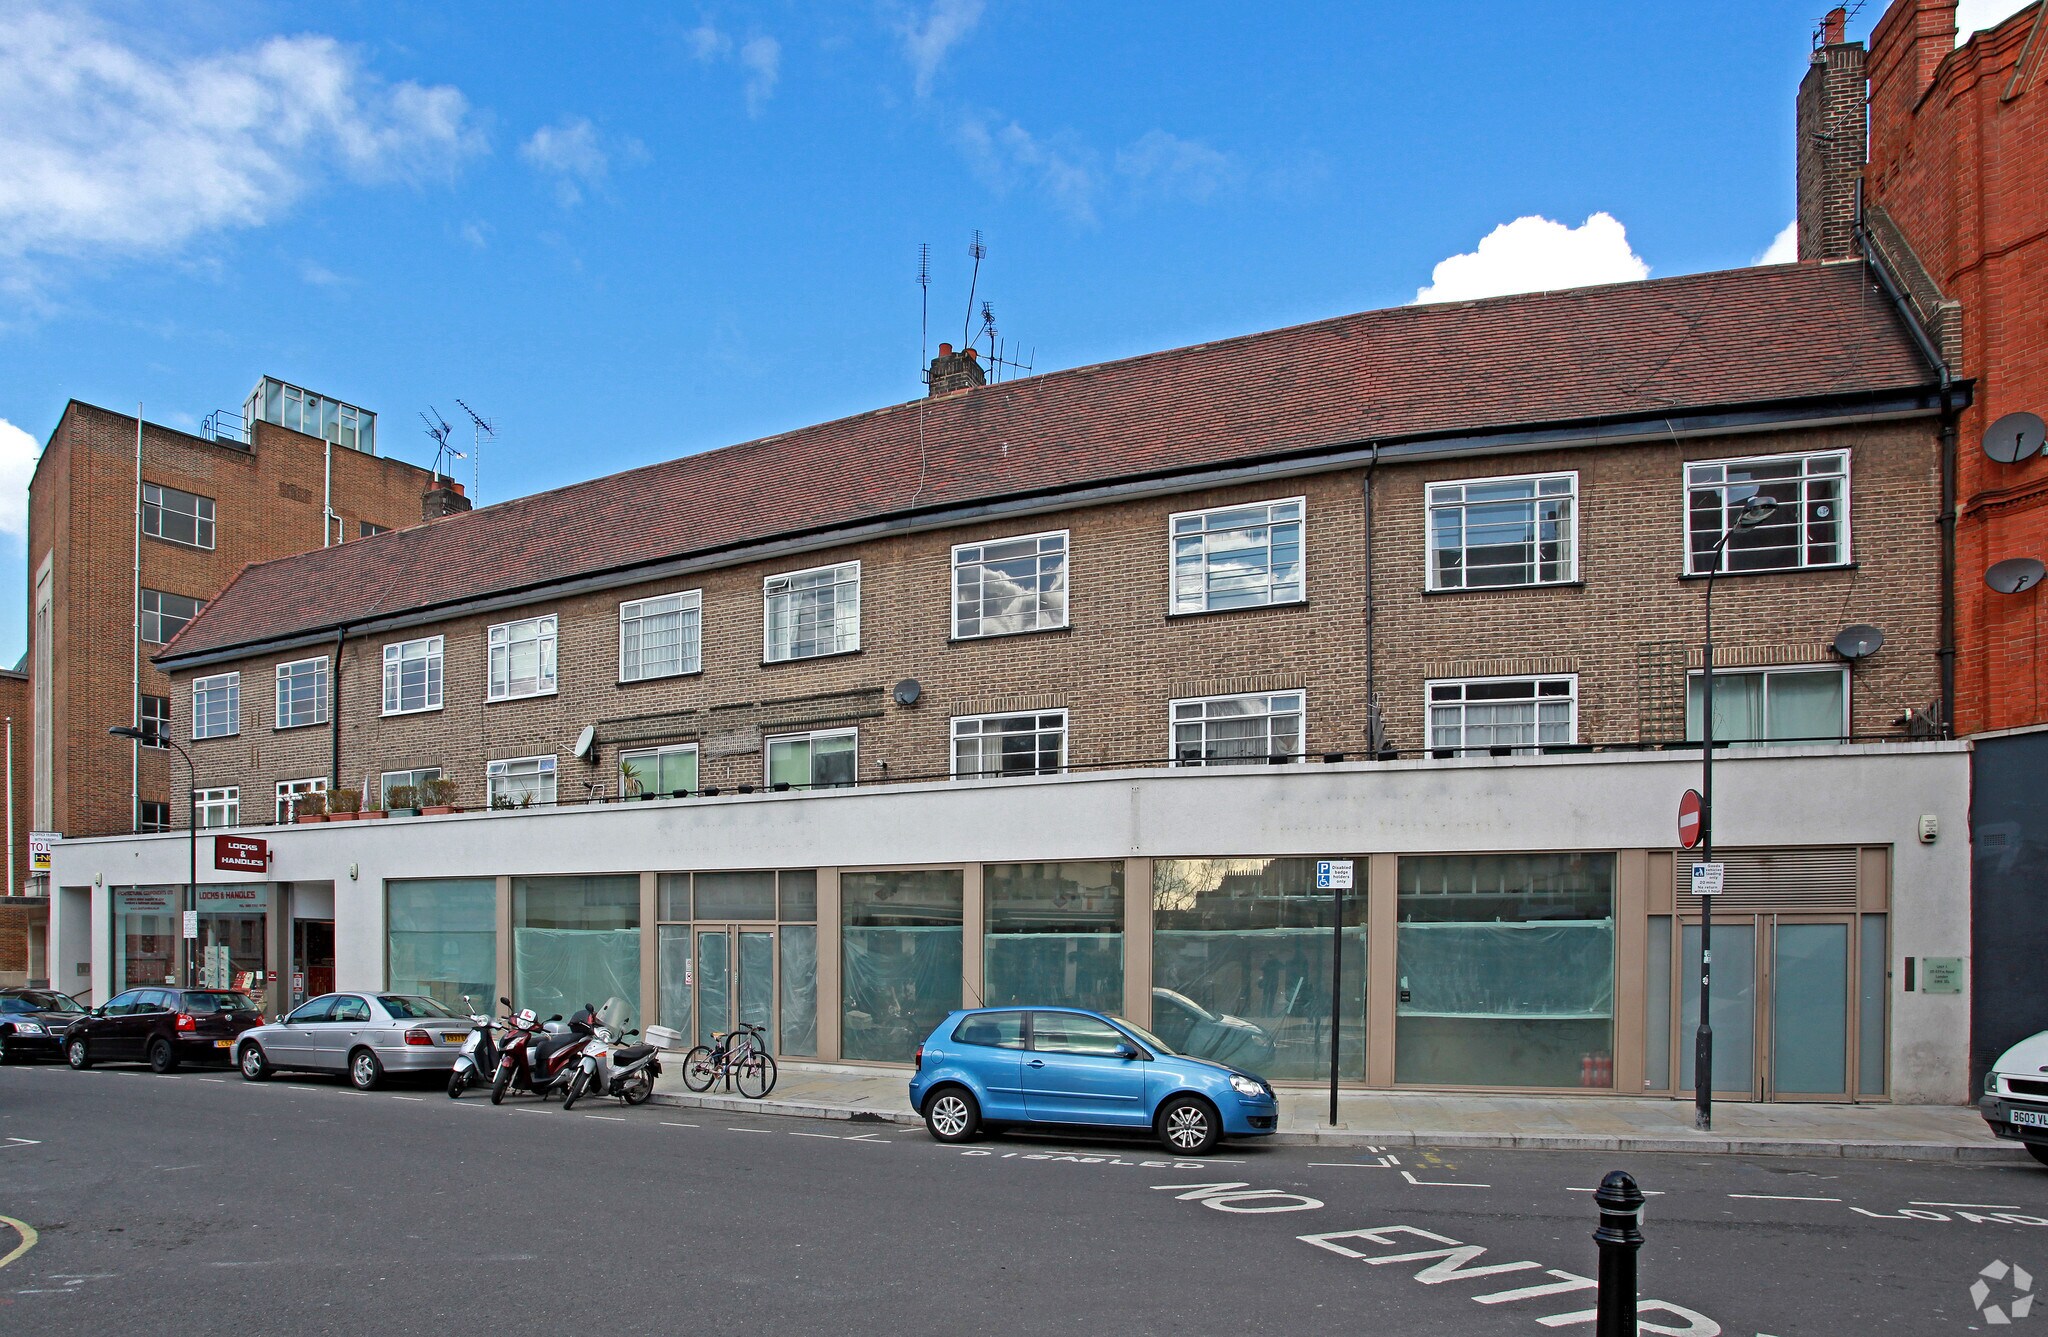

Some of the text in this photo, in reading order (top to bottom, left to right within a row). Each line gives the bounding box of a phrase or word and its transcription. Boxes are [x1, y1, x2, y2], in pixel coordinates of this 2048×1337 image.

[30, 842, 44, 851] TO
[228, 842, 258, 850] LOCKS
[222, 857, 264, 866] HANDLES
[1321, 864, 1328, 873] P
[200, 892, 220, 900] LOCKS
[226, 891, 256, 899] HANDLES
[2014, 1112, 2035, 1123] BG03
[961, 1150, 1205, 1169] DISABLED
[1150, 1182, 1325, 1214] NO
[1296, 1225, 1779, 1337] ENTR
